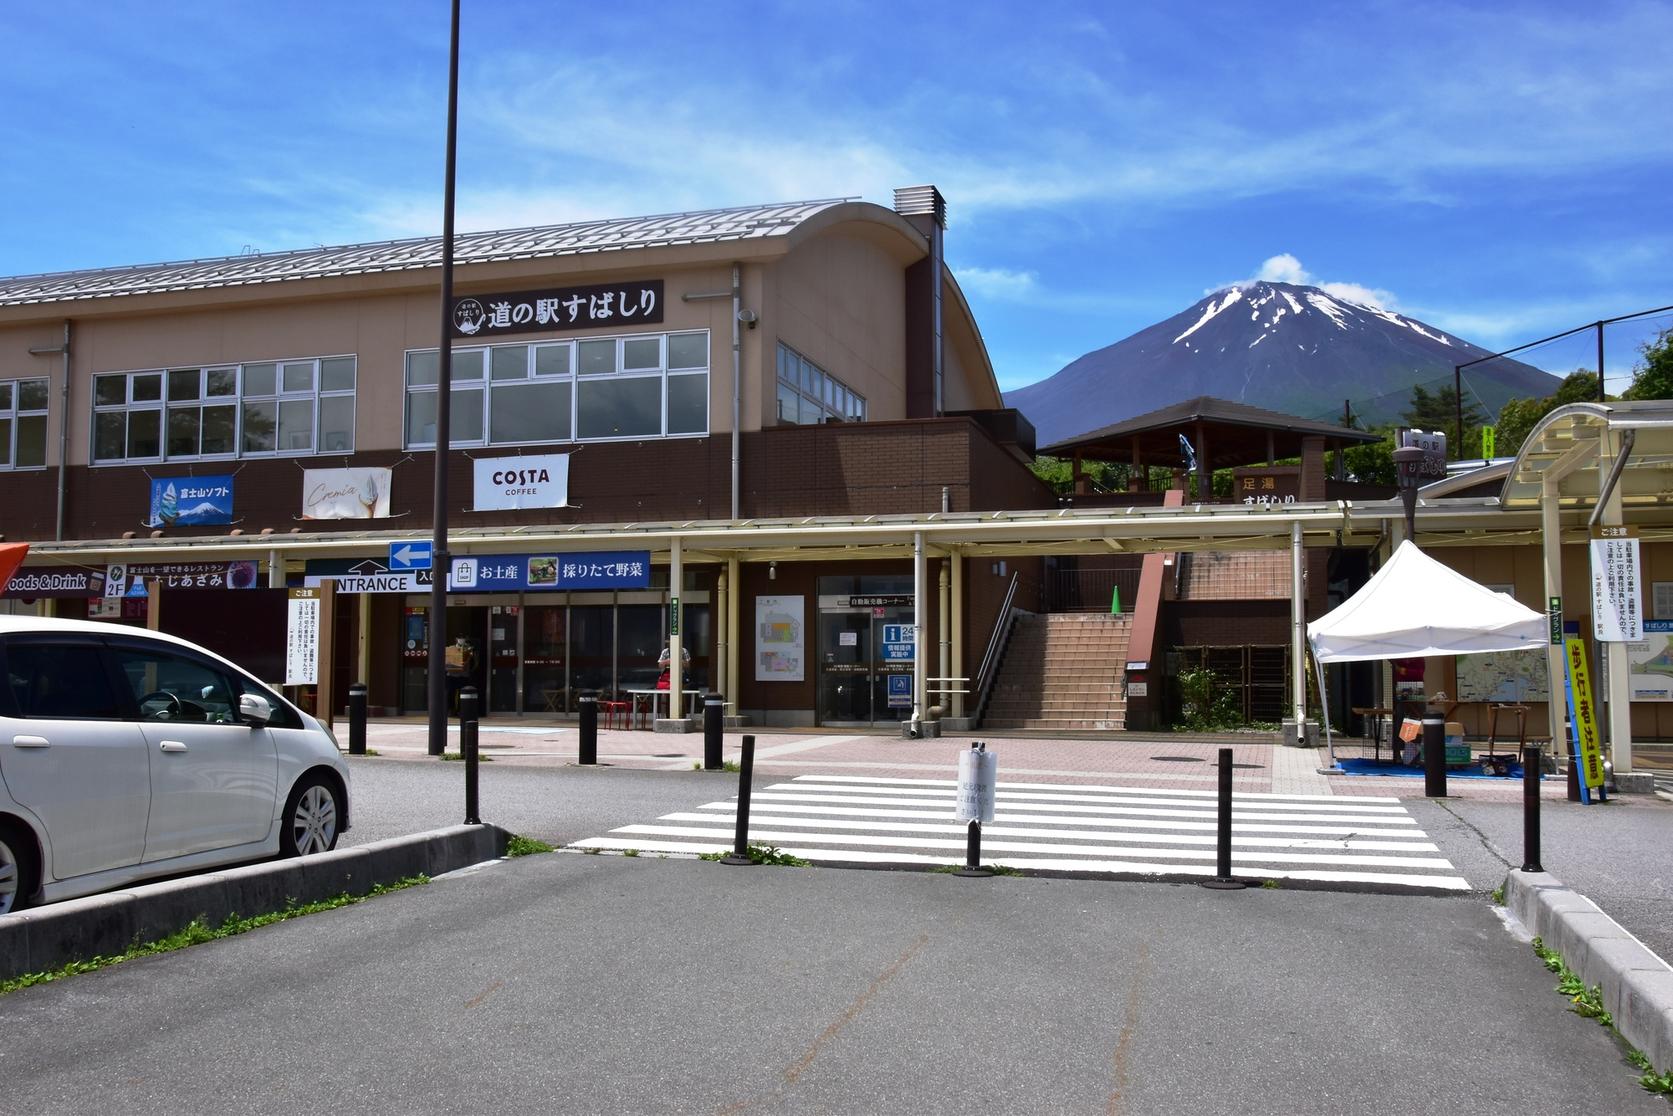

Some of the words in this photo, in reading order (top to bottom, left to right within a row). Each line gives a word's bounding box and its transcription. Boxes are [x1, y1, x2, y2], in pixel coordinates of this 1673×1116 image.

[457, 309, 480, 317] すばしり
[488, 289, 656, 329] 道の駅すばしり
[492, 468, 550, 486] COSTA
[1242, 477, 1275, 490] 足湯
[180, 486, 229, 499] 富士山ソフト
[505, 488, 537, 496] COFFEE
[1601, 527, 1628, 537] ご注意
[480, 565, 518, 579] お土産
[563, 562, 643, 579] 採りたて野菜
[6, 574, 39, 591] oods
[40, 575, 51, 590] &
[336, 577, 408, 592] NTRANCE
[107, 584, 124, 596] 2F
[295, 589, 313, 597] ご注意
[902, 627, 914, 636] 24
